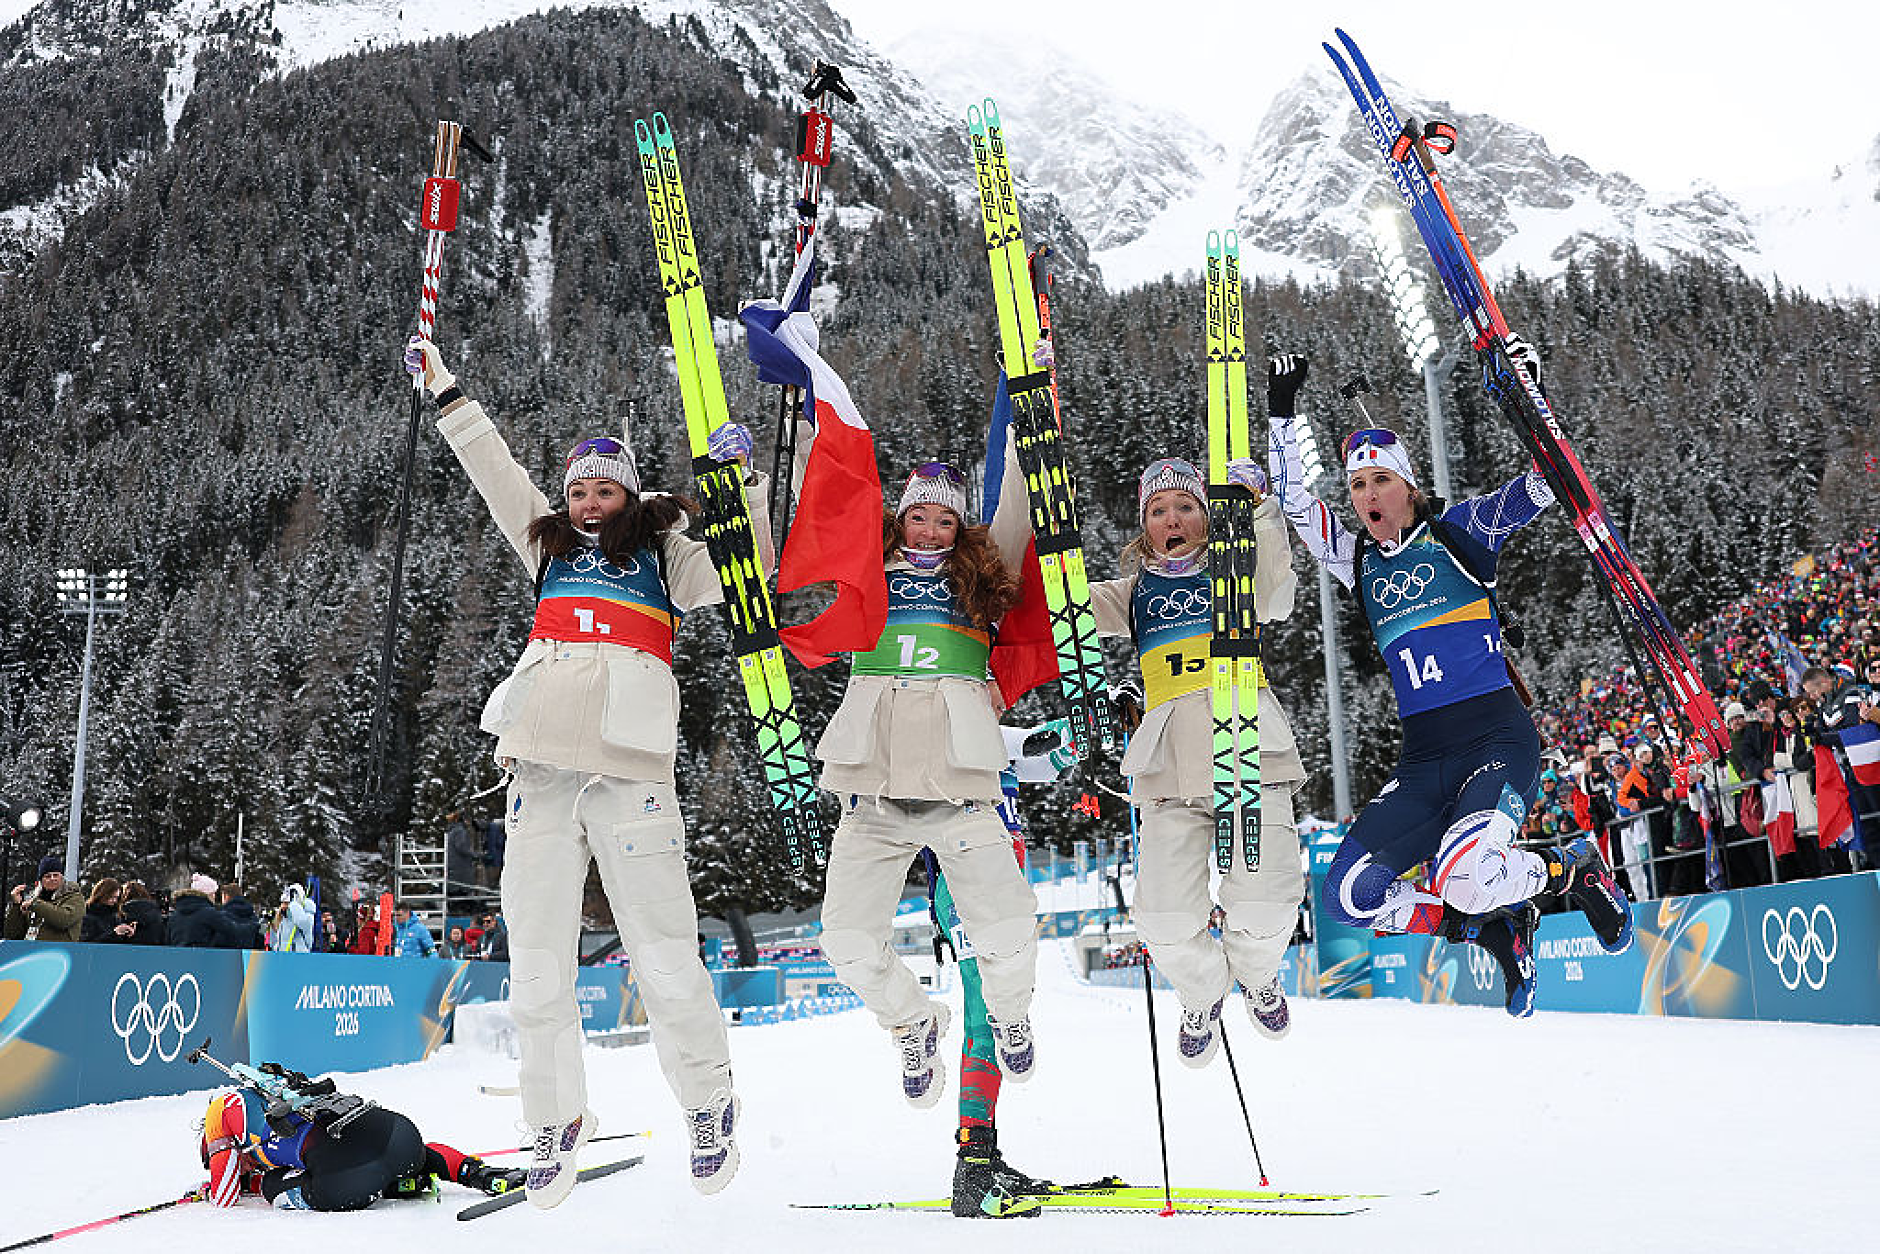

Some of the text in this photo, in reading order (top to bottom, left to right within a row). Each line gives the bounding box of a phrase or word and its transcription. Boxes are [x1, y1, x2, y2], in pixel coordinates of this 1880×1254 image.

[973, 133, 997, 223] FISCHER
[989, 126, 1015, 216] FISCHER
[1376, 96, 1428, 195] SALMON
[642, 153, 673, 264] FISCHER
[661, 147, 692, 257] FISCHER
[1207, 256, 1221, 340] FISCHER
[1225, 254, 1242, 340] FISCHER
[1510, 355, 1565, 440] SALOMON
[1399, 647, 1444, 690] 14
[1218, 818, 1231, 867] SPEED
[1246, 816, 1258, 866] SPEED
[1538, 940, 1570, 959] MILANO
[295, 984, 395, 1010] MILANO CORTINA
[335, 1011, 359, 1036] 2026
